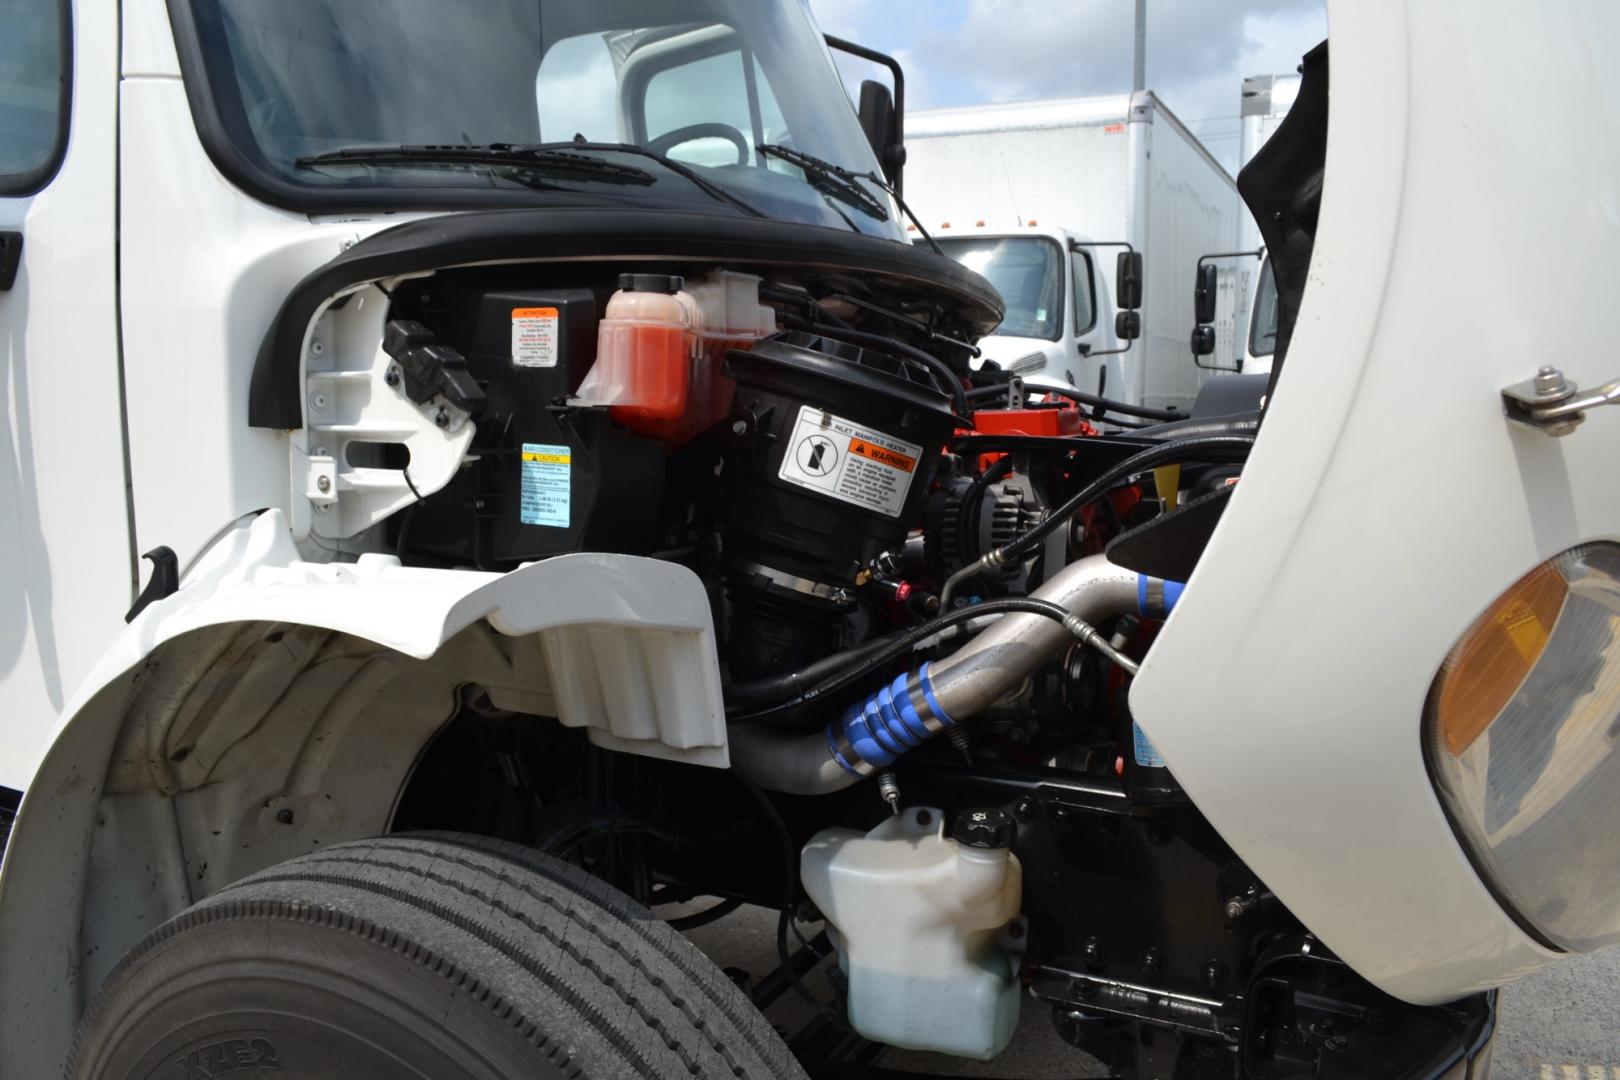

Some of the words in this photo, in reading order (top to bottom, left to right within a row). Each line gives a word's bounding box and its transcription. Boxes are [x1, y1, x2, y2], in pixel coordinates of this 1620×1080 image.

[835, 424, 852, 434] INLET
[855, 431, 885, 445] MANIFOLD
[886, 442, 906, 452] HEATER
[871, 449, 910, 468] WARNING
